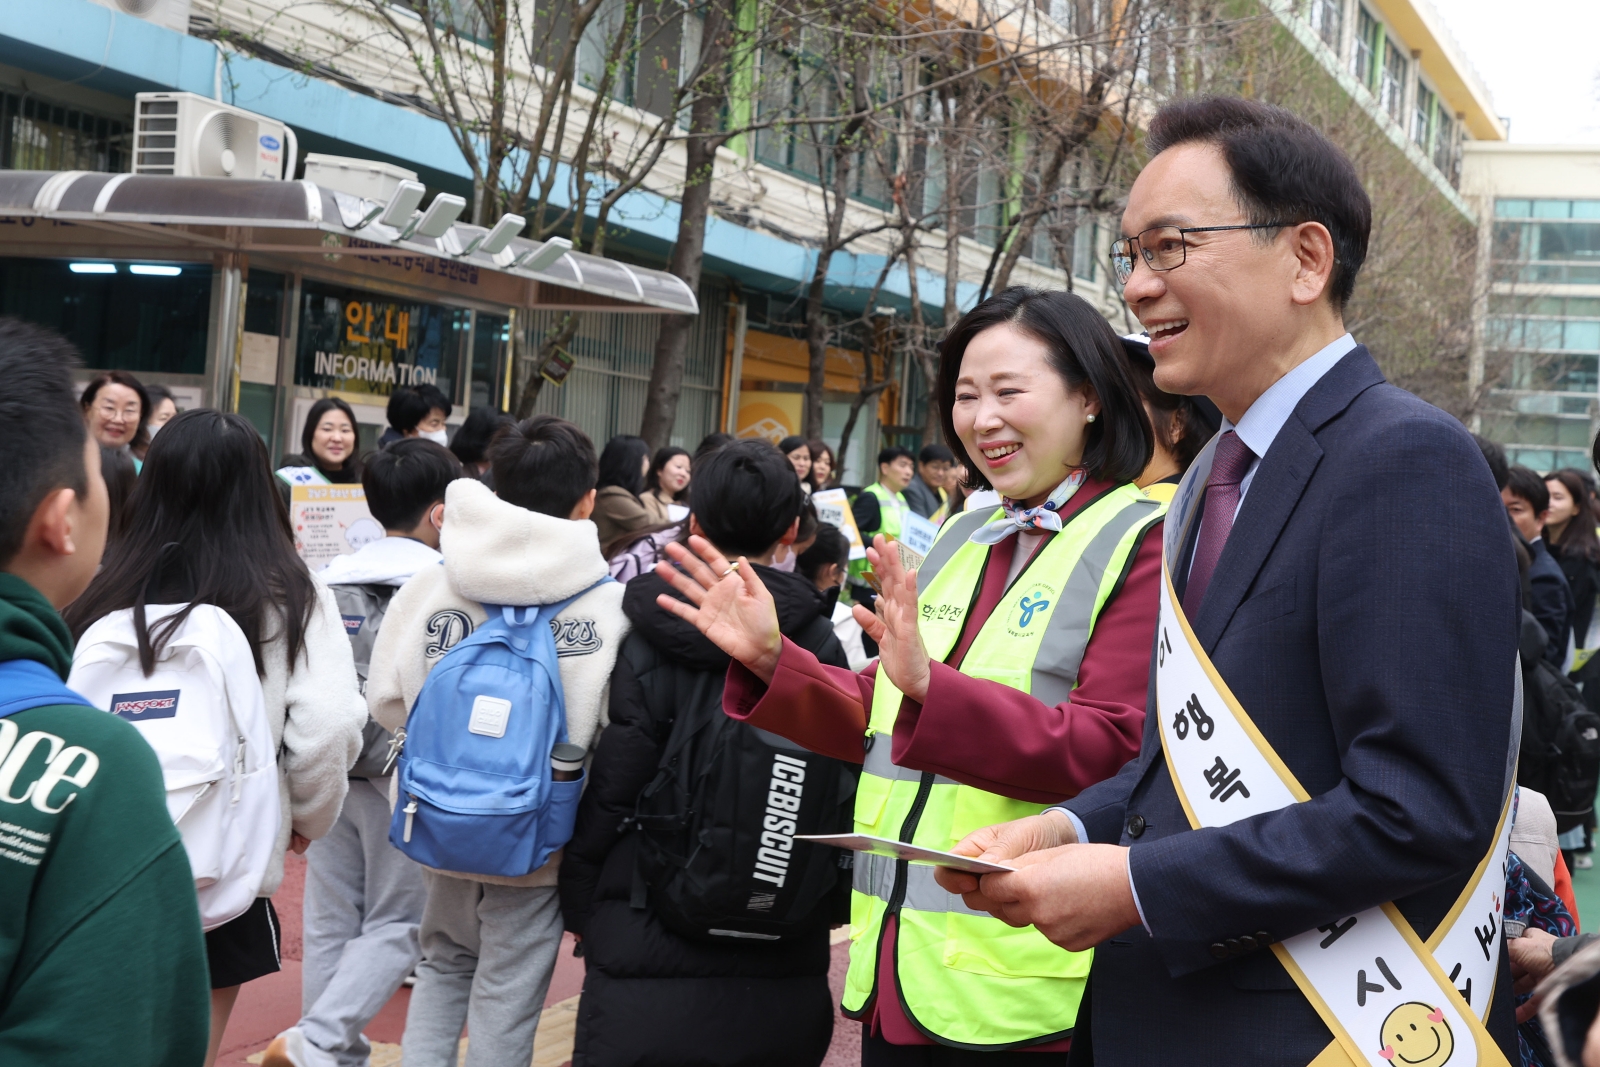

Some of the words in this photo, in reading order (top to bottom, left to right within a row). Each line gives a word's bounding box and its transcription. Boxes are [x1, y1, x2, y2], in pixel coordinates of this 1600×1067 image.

[345, 301, 409, 350] 안내
[314, 350, 437, 386] INFORMATION
[922, 603, 965, 622] 학안전
[425, 609, 602, 659] Ders
[112, 697, 176, 715] JANSPORT
[752, 753, 808, 888] ICEBISCUIT
